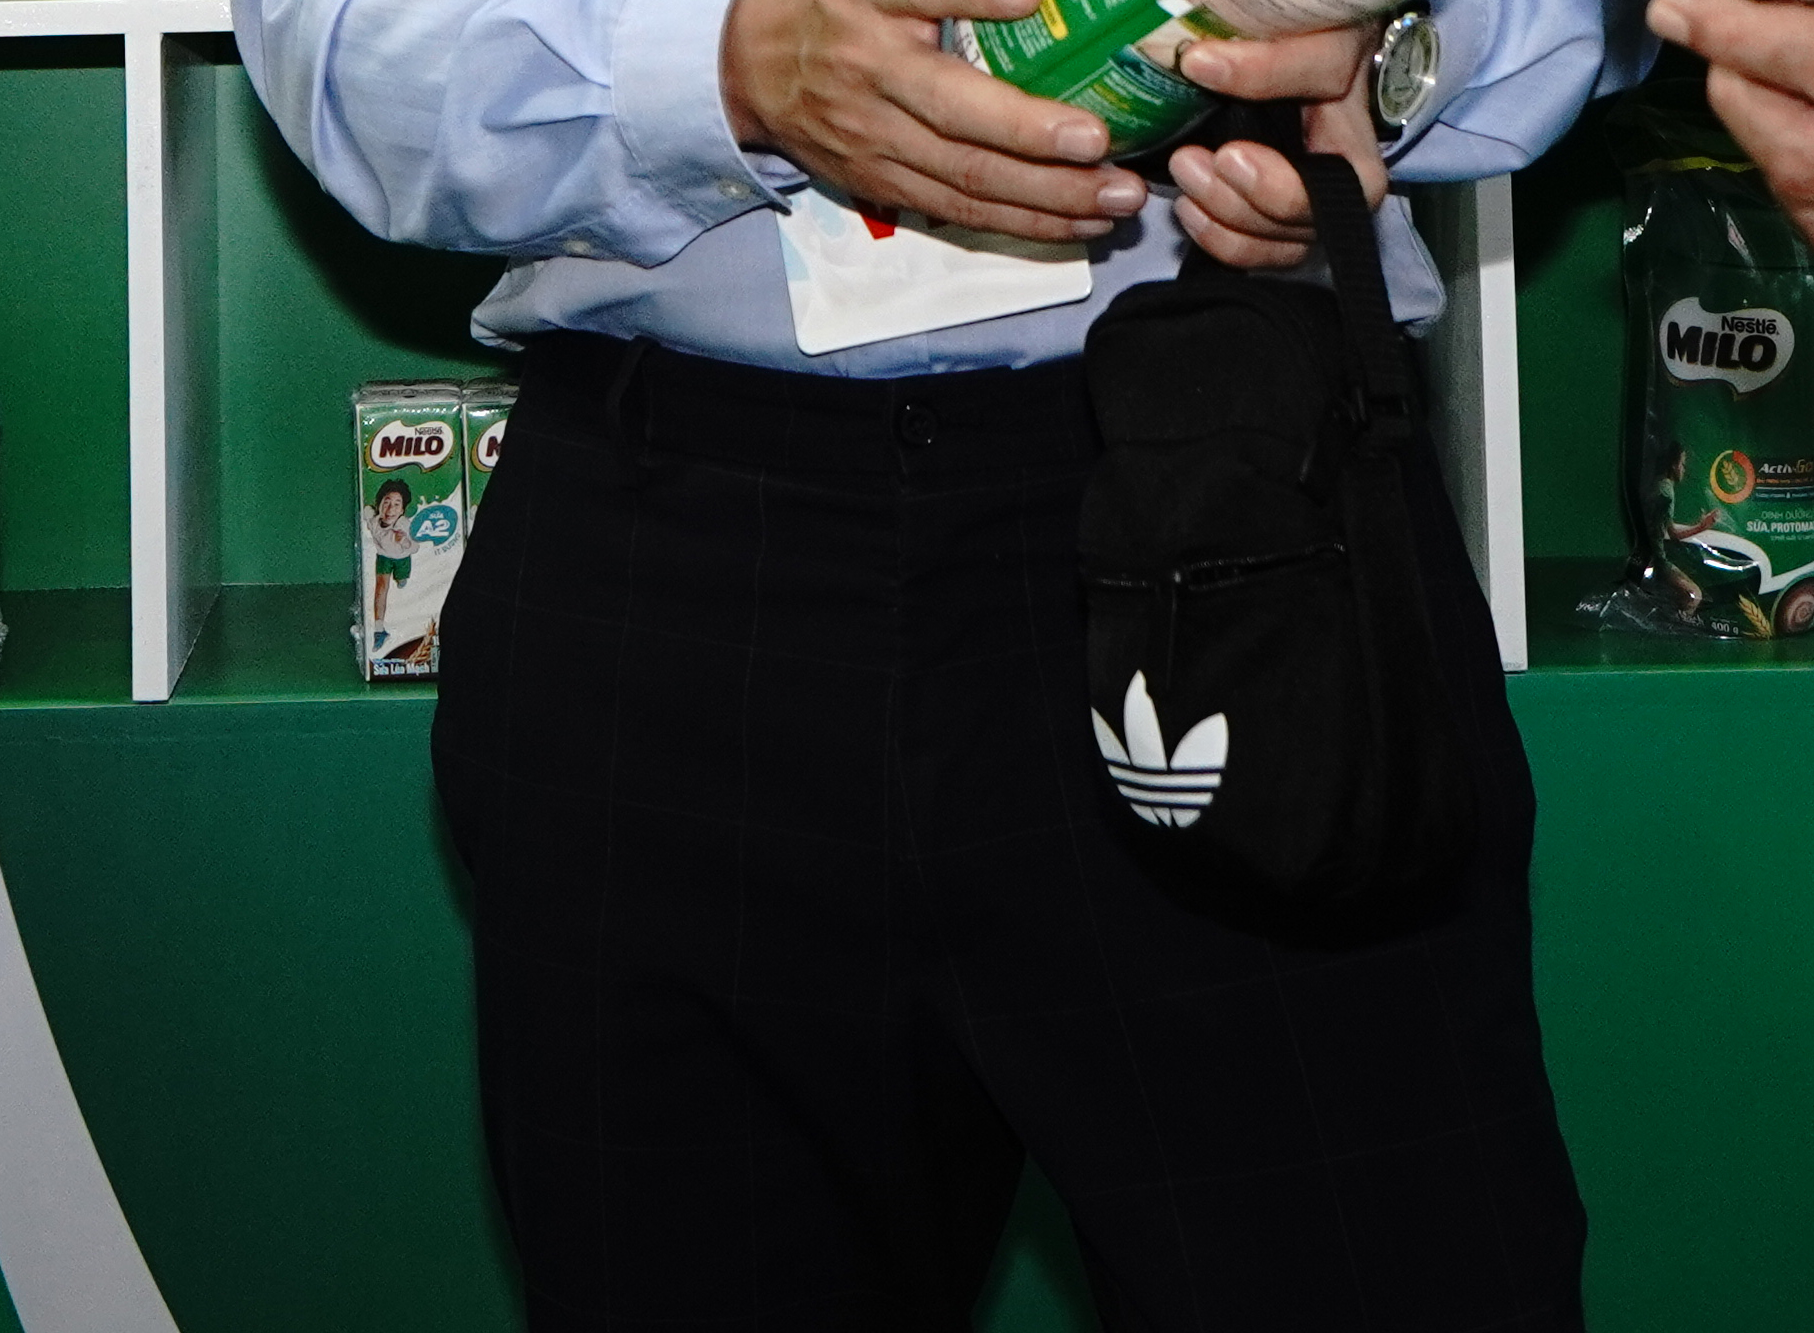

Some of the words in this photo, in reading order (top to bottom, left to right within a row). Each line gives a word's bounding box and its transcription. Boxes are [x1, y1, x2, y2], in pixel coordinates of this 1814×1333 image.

[1667, 321, 1777, 372] MILO
[379, 435, 444, 459] MILO
[415, 519, 451, 537] A2
